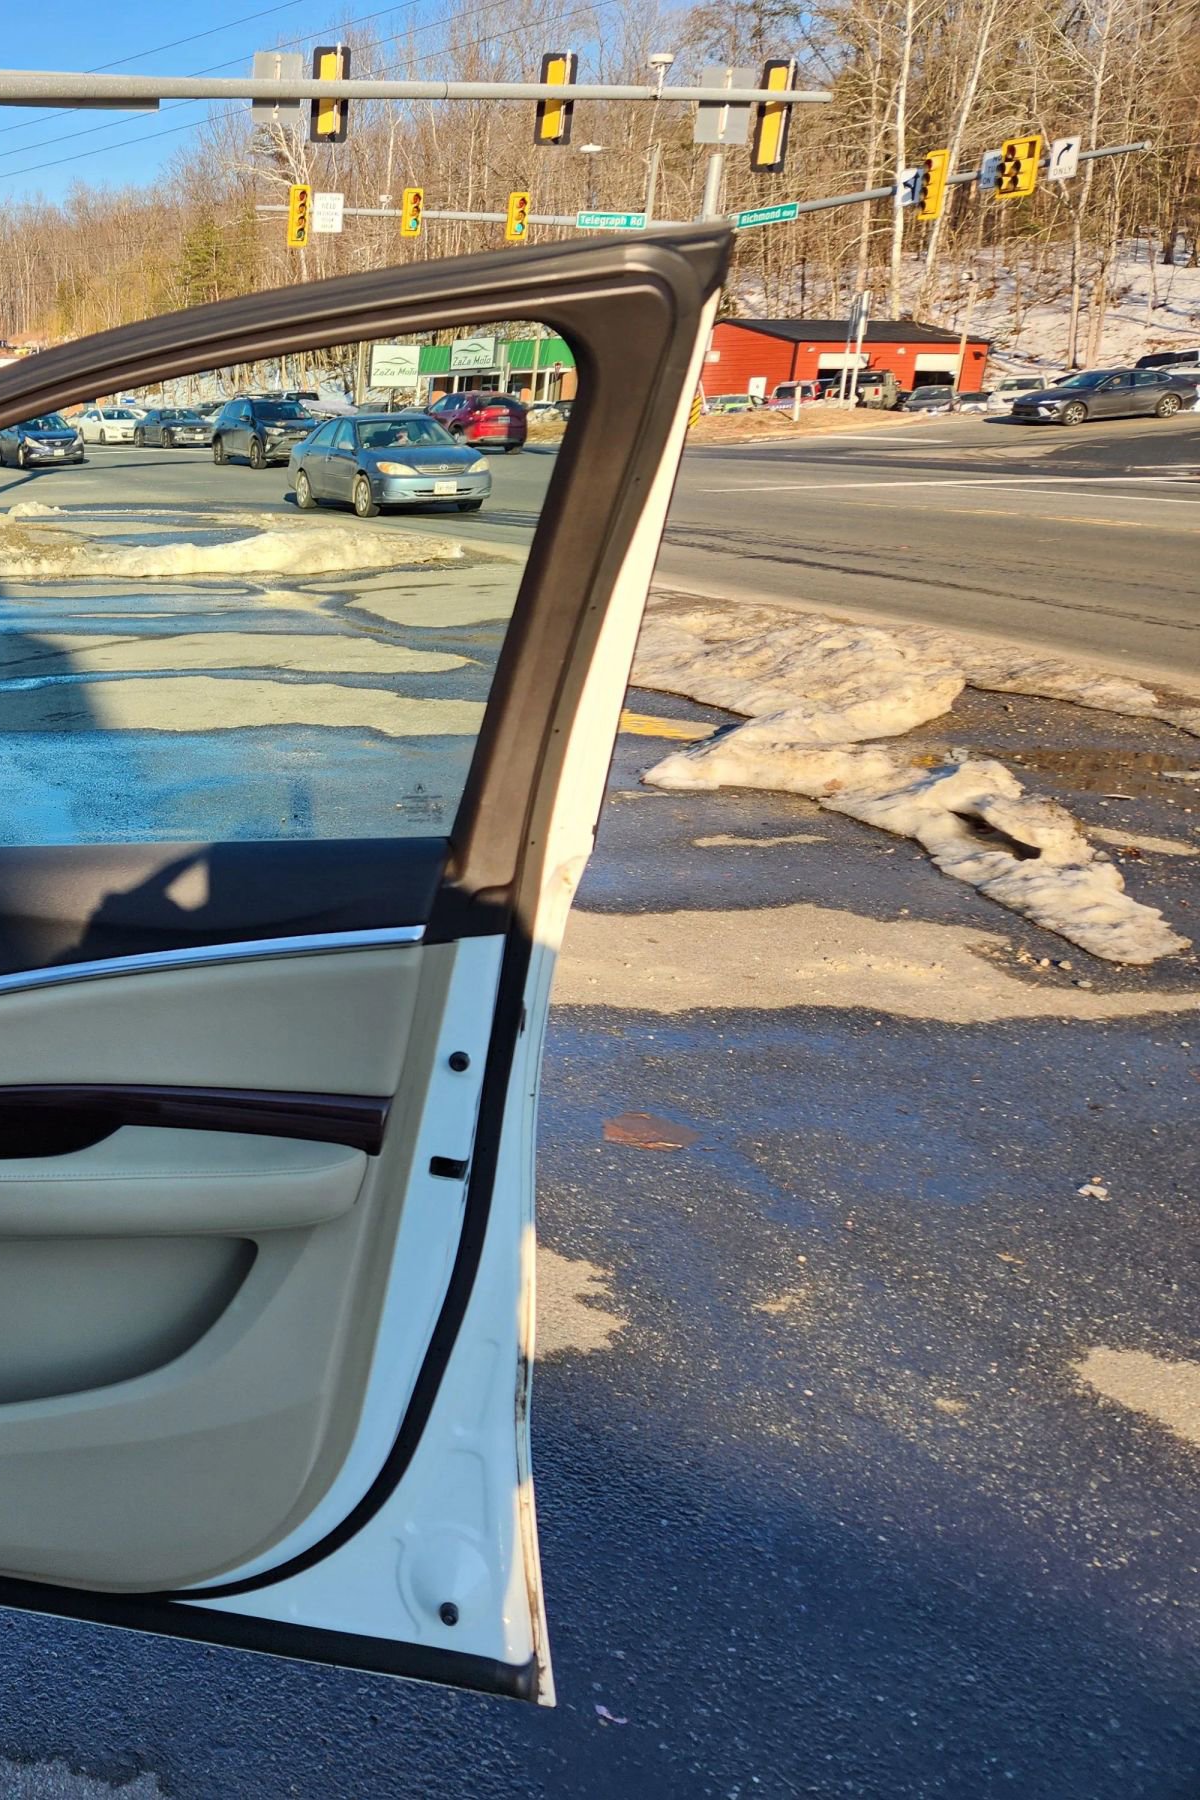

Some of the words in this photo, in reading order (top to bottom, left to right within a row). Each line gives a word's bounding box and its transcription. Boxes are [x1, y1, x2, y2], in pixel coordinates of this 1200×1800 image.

[1053, 166, 1073, 176] ONLY
[580, 214, 627, 227] Telegraph
[629, 216, 643, 226] Rd
[741, 207, 782, 225] Richmond
